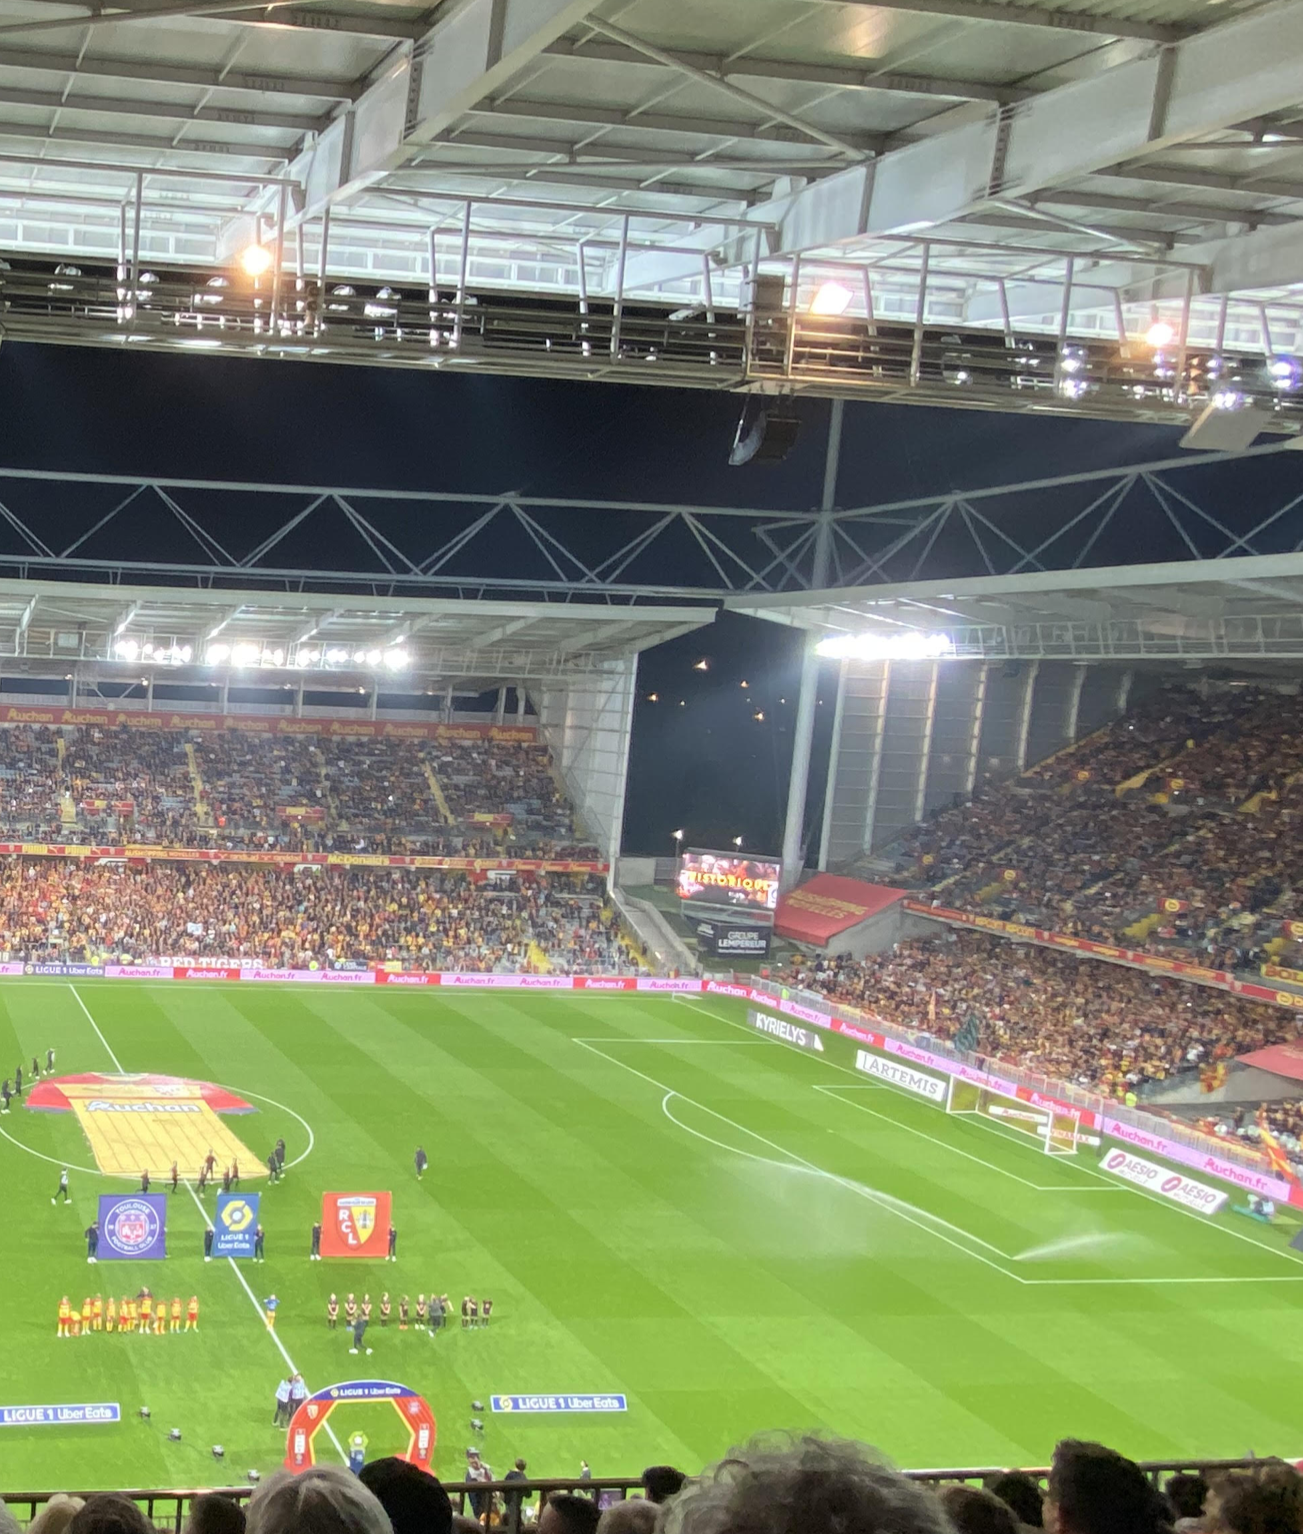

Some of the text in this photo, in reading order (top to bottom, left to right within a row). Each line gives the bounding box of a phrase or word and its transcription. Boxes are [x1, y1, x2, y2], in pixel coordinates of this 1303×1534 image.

[7, 708, 53, 722] Auchan
[61, 710, 108, 724] Auchan
[170, 715, 216, 729] Auchan
[224, 717, 269, 731] Auchan
[277, 719, 322, 733] Auchan
[330, 721, 375, 735] Auchan
[383, 724, 428, 737] Auchan
[488, 727, 533, 741] Auchan
[718, 939, 766, 948] LEMPEREUR
[160, 956, 263, 970] RED TIGERS
[36, 966, 60, 975] LIGUE
[69, 967, 84, 975] Uber
[85, 967, 103, 976] Eats
[119, 967, 161, 977] Auchan.fr
[186, 969, 228, 979] Auchan.fr
[254, 970, 295, 980] Auchan.fr
[321, 972, 362, 982] Auchan.fr
[387, 973, 429, 984] Auchan.fr
[454, 976, 495, 986] Auchan.fr
[520, 977, 561, 987] Auchan.fr
[649, 980, 689, 990] Auchan.fr
[707, 981, 747, 997] Auchan
[750, 989, 777, 1007] Auchan
[789, 1002, 820, 1023] Auchan.fr
[756, 1013, 806, 1046] KYRIELYS
[840, 1022, 874, 1043] Auchan.fr
[896, 1044, 934, 1065] Auchan.fr
[869, 1056, 938, 1095] ARTEMIS
[85, 1100, 201, 1113] Auchan
[1030, 1092, 1081, 1118] Auchan.fr
[1111, 1123, 1167, 1153] Auchan.fr
[1204, 1158, 1267, 1191] Auchan.fr
[115, 1203, 151, 1214] TOULOUSE
[110, 1236, 139, 1251] FOOTBALL
[340, 1388, 363, 1396] LIGUE
[519, 1397, 619, 1409] LIGUE 1 Uber Eats
[3, 1406, 112, 1421] LIGUE 1 Uber Eats
